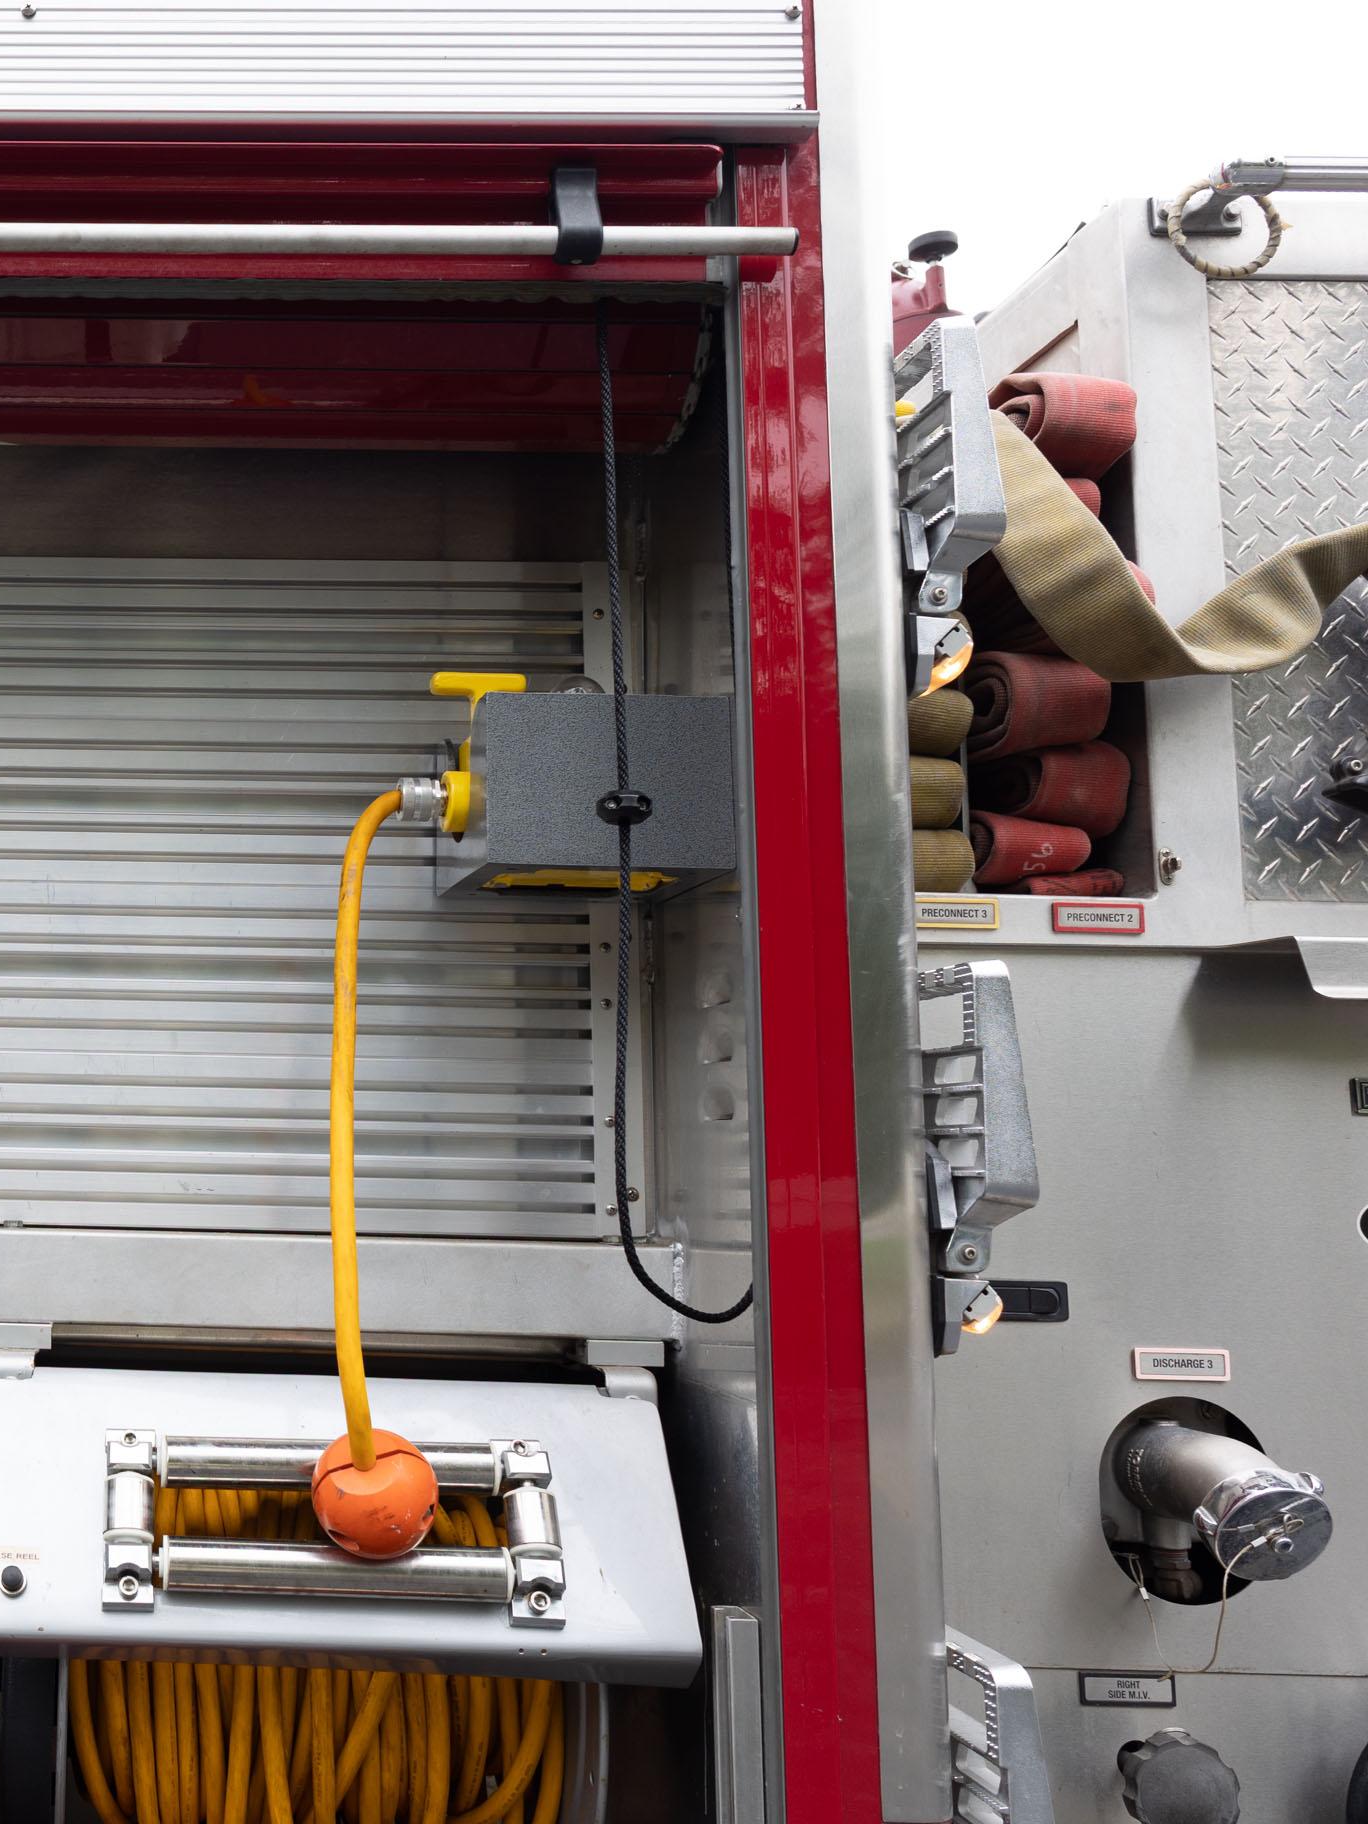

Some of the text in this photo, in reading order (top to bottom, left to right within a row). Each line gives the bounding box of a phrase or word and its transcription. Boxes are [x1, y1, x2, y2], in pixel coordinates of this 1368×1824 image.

[921, 908, 988, 919] PRECONNECT 3
[1066, 912, 1134, 923] PRECONNECT 2
[1152, 1358, 1214, 1369] DISCHARGE 3
[16, 1552, 40, 1560] REEL
[1116, 1680, 1140, 1689] RIGHT
[1107, 1690, 1151, 1700] SIDE M.I.V.
